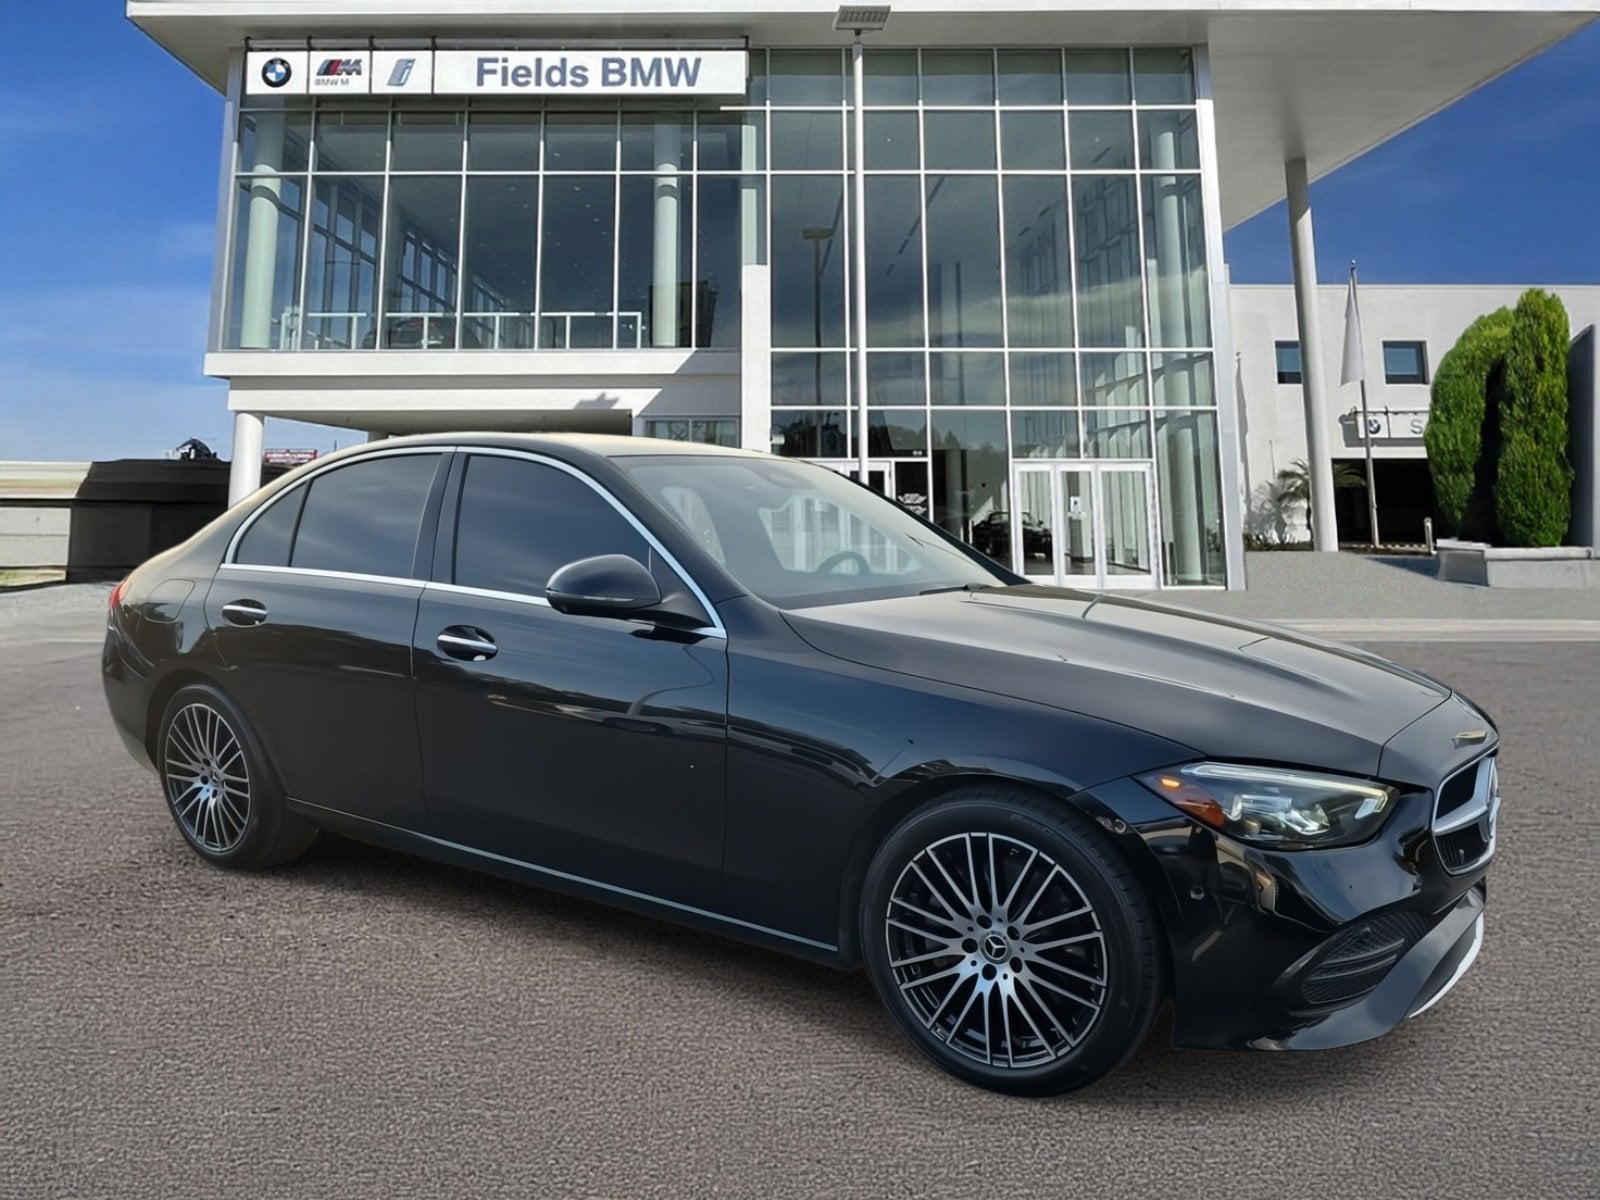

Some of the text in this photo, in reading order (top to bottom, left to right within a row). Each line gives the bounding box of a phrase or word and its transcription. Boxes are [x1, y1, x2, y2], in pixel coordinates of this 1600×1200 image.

[476, 57, 702, 87] Fields BMW
[315, 78, 339, 86] BMW
